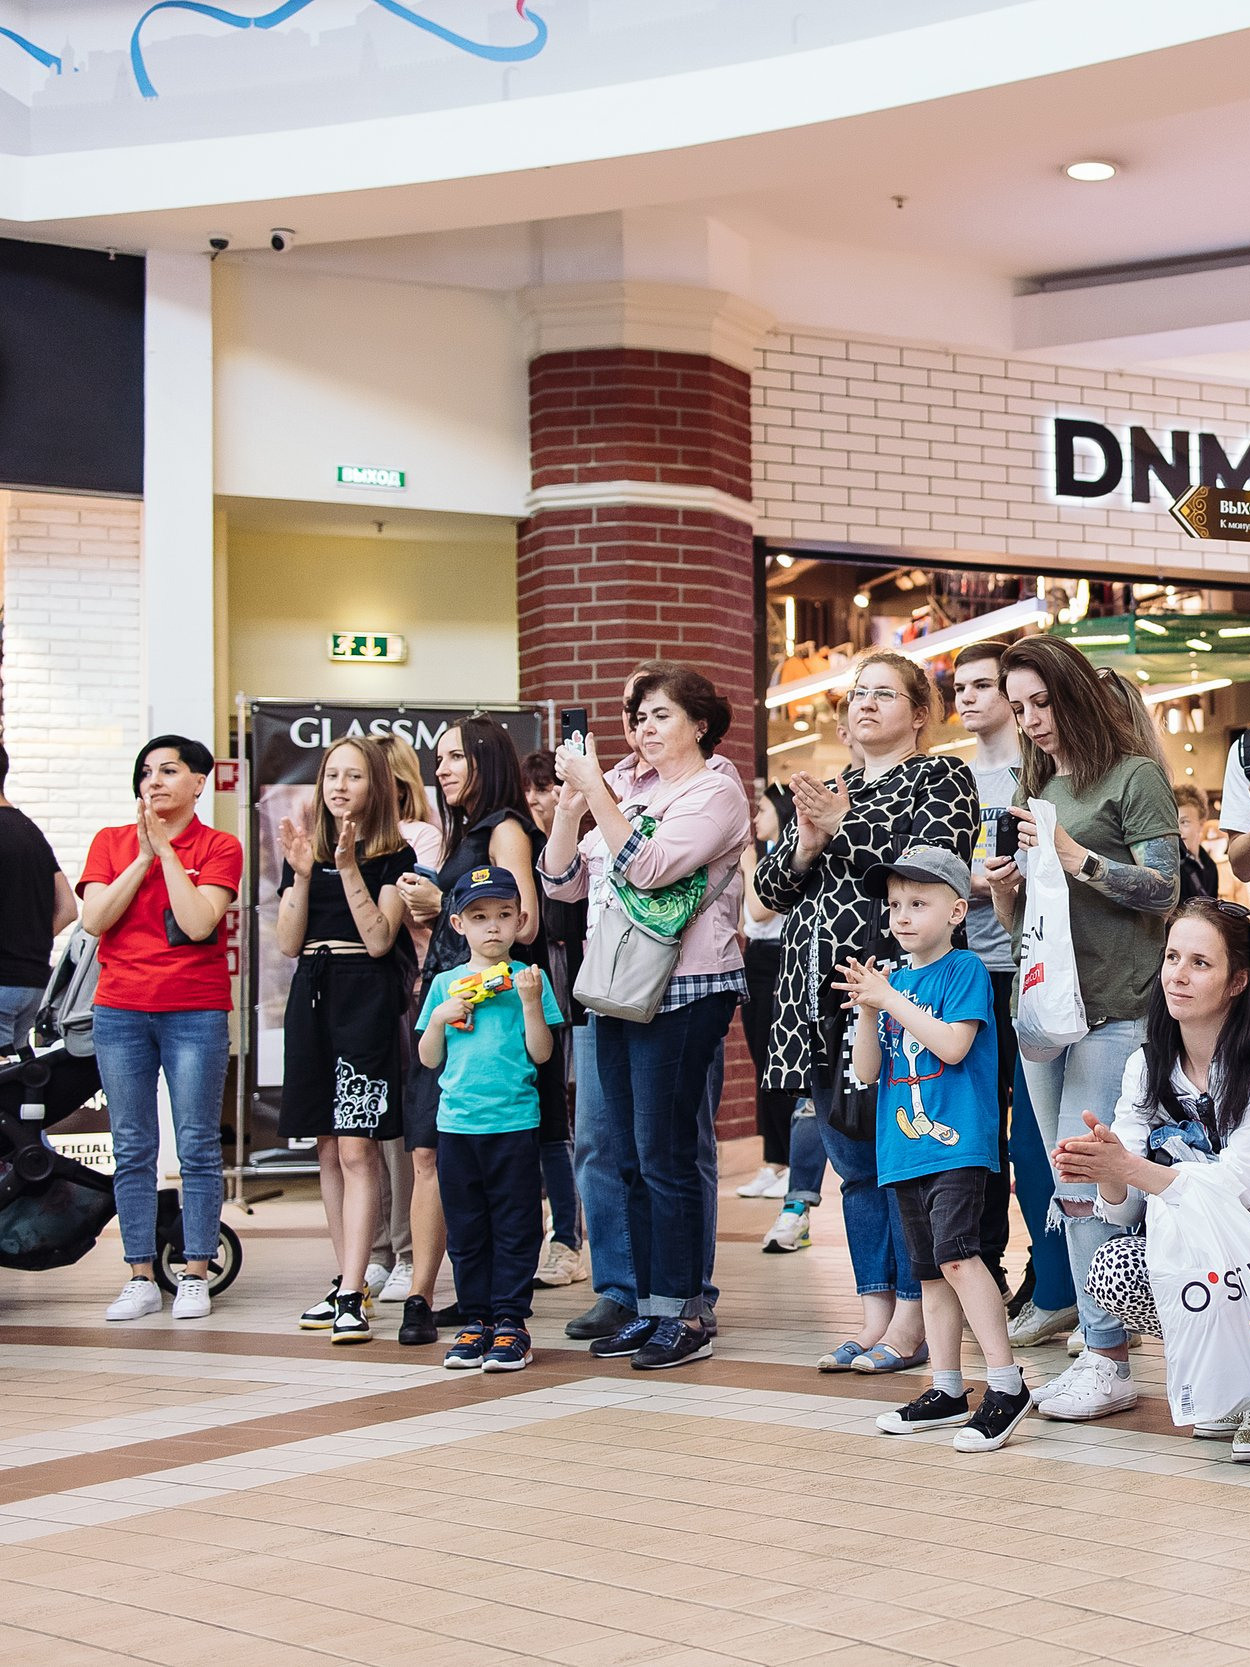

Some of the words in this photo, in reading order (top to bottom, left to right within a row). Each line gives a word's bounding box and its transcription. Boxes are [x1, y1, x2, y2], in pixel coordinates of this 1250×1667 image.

[341, 466, 400, 487] ВЫХОД
[1220, 519, 1227, 529] К
[289, 717, 448, 750] GLASSM
